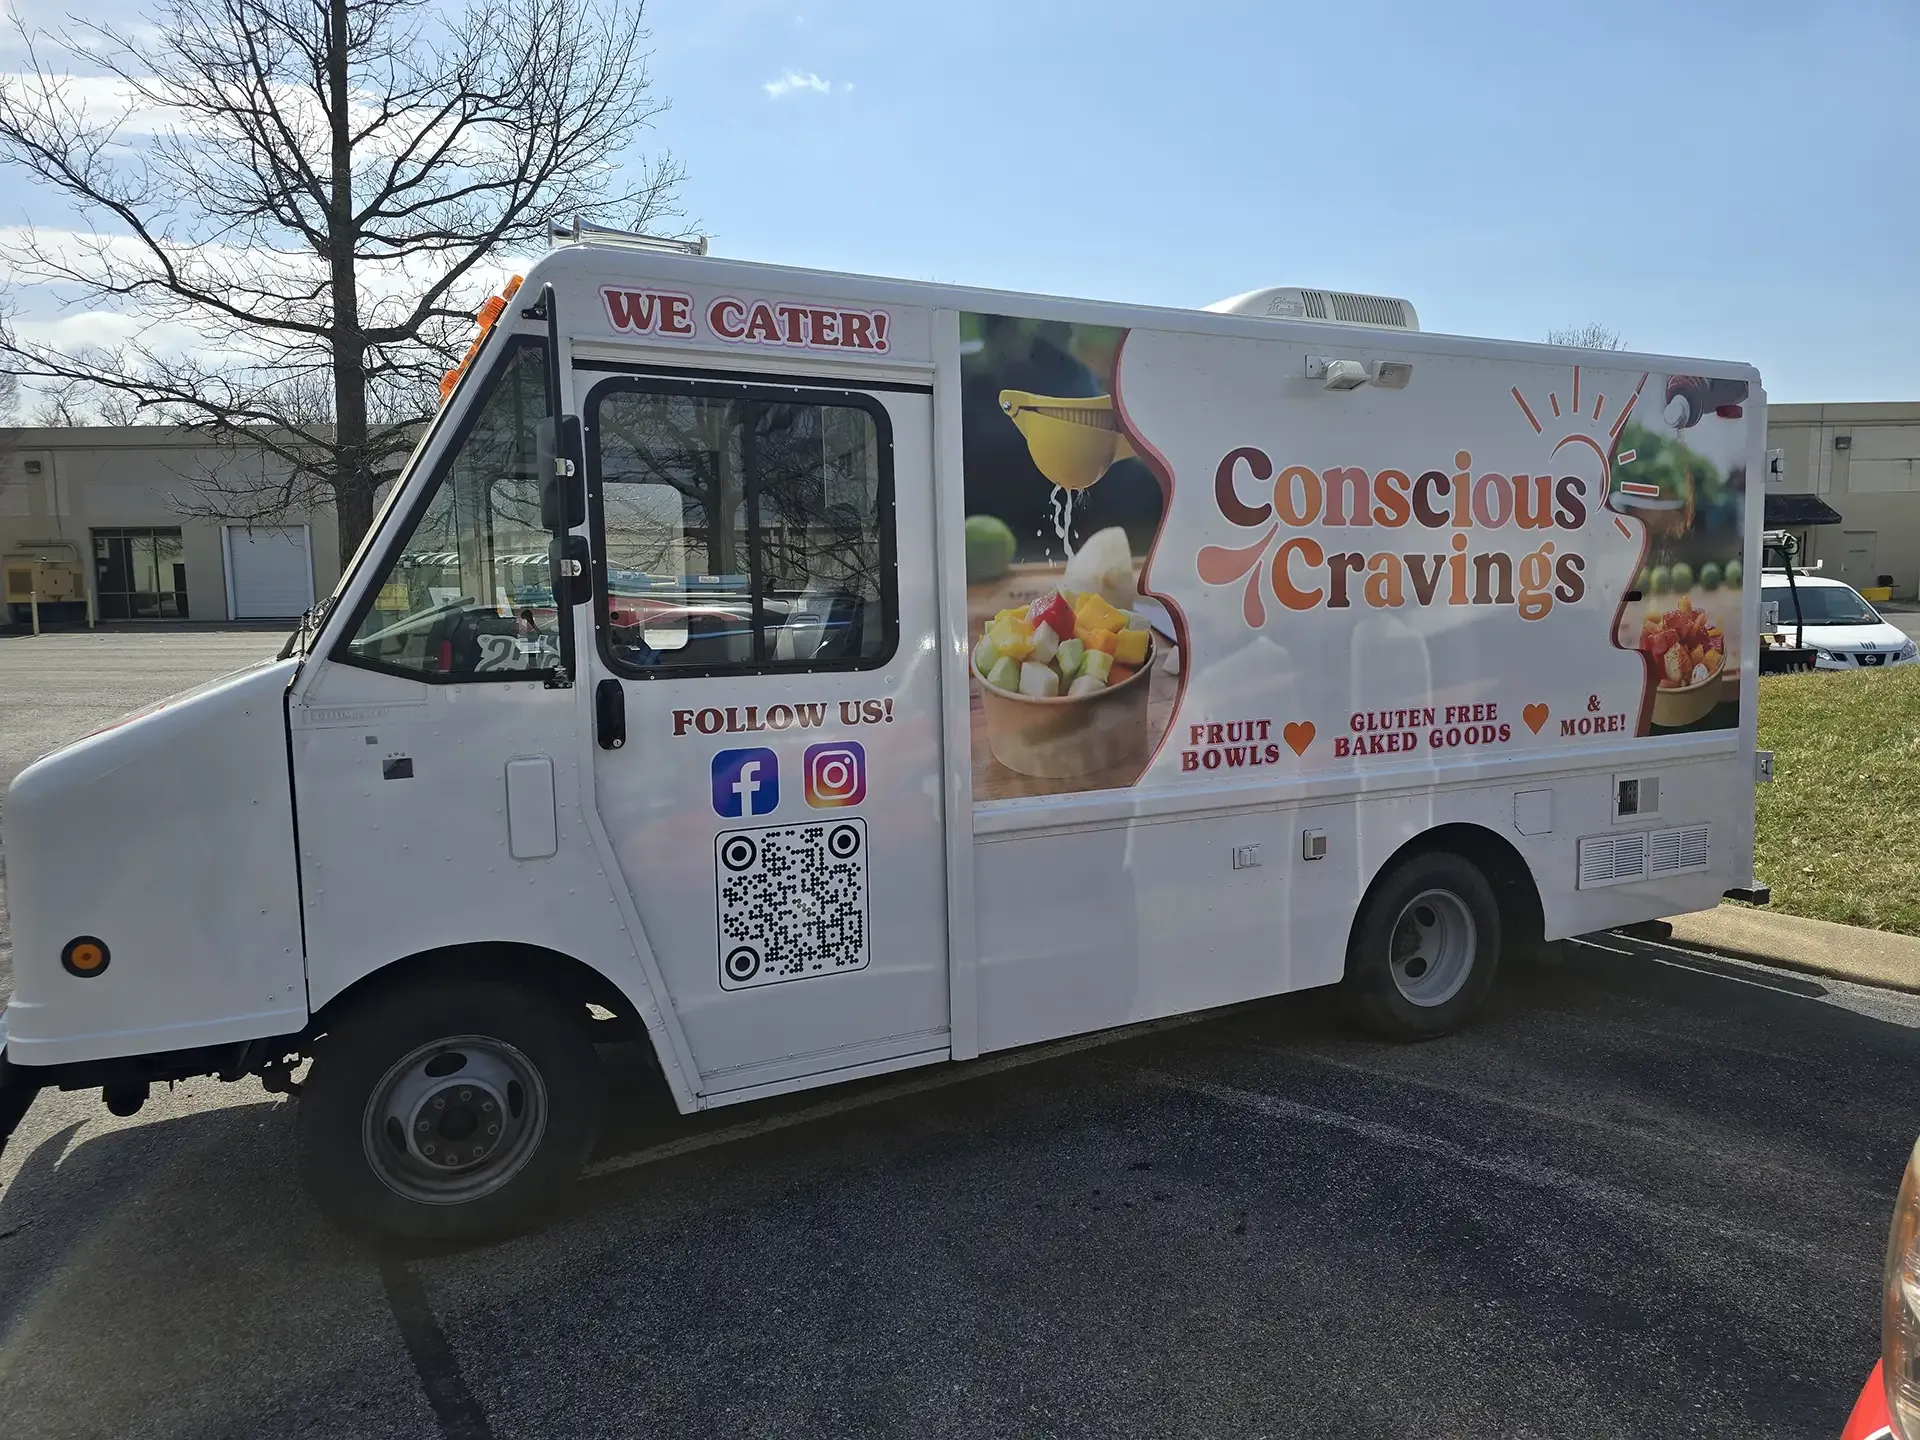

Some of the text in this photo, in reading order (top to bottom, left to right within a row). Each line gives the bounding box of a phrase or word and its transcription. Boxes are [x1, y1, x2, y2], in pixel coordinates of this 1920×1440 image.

[603, 289, 888, 350] WE CATER!
[1215, 446, 1587, 529] Conscious
[1271, 532, 1586, 621] Cravings
[672, 698, 894, 736] FOLLOW US!
[1350, 703, 1498, 733] GLUTEN FREE
[1587, 694, 1601, 712] &
[1189, 719, 1272, 746] FRUIT
[1334, 724, 1511, 758] BAKED GOODS
[1560, 714, 1627, 737] MORE!
[1181, 744, 1280, 772] BOWLS
